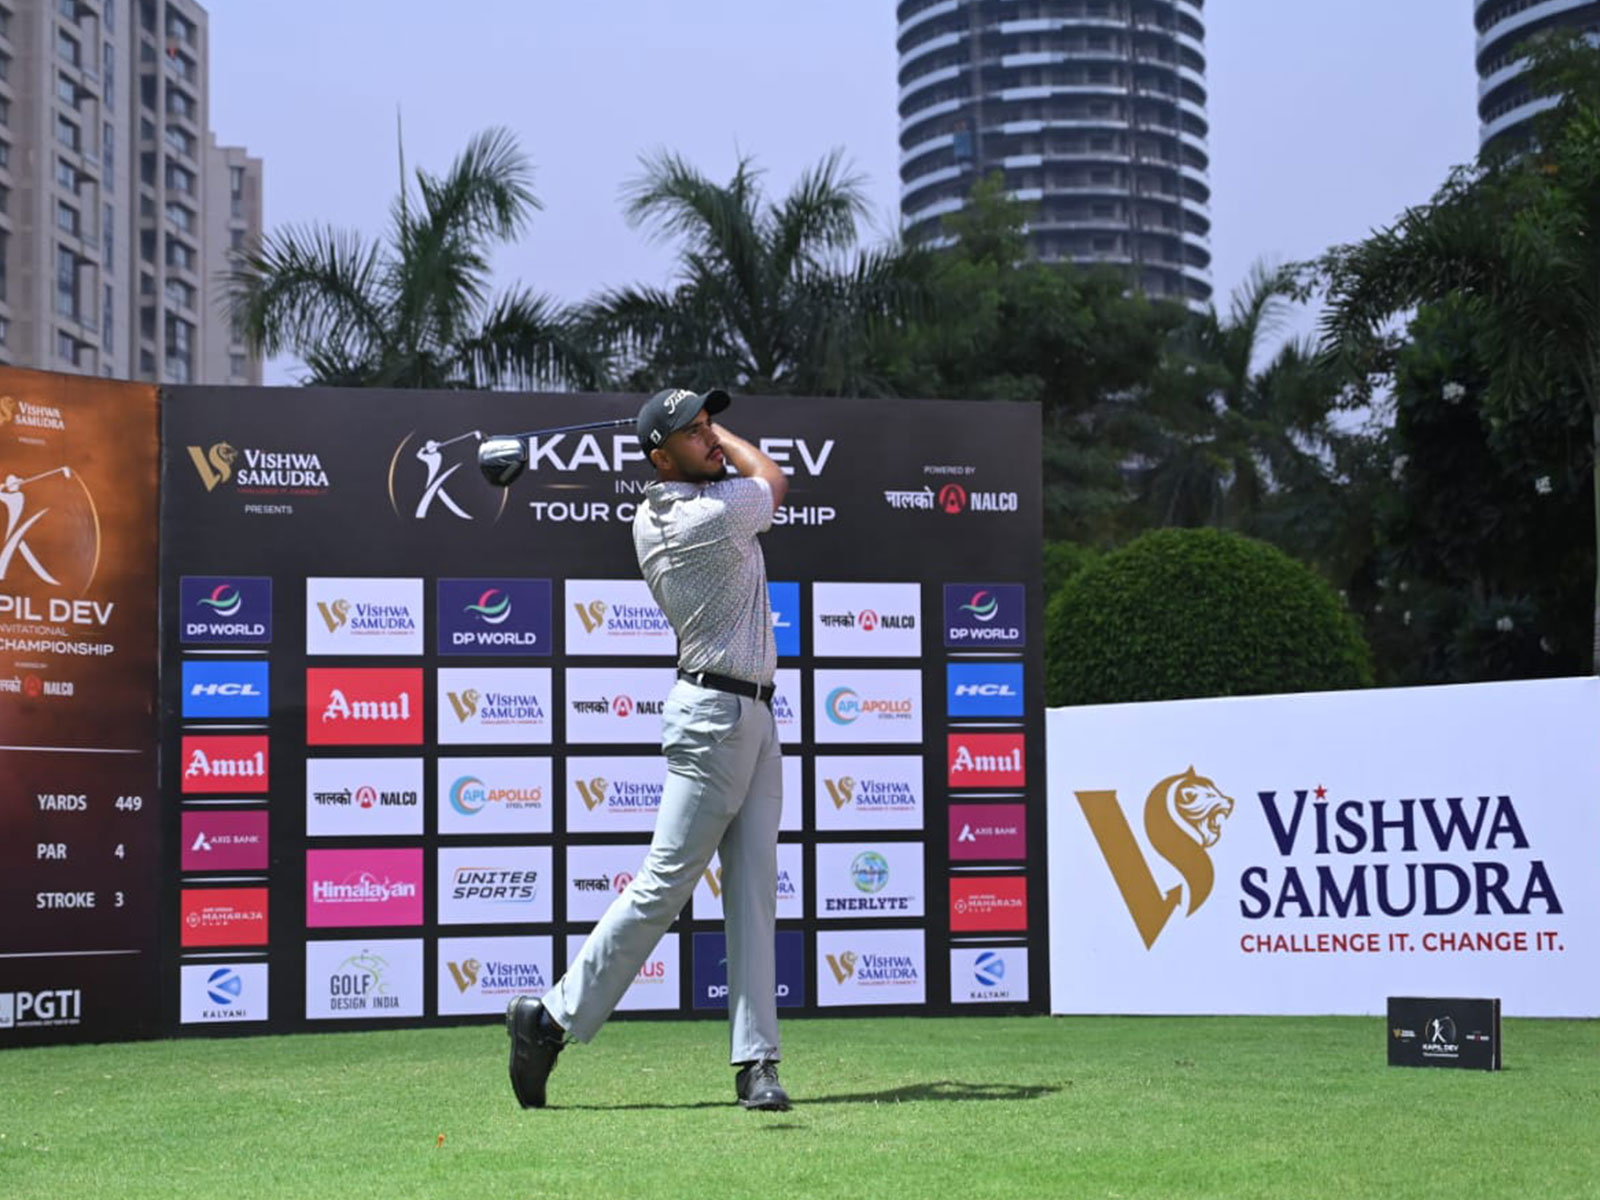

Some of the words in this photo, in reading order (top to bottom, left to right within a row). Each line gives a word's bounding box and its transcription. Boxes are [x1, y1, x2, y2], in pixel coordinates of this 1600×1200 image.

[244, 449, 322, 469] VISHWA
[760, 438, 835, 476] EV
[237, 469, 330, 487] SAMUDRA
[884, 486, 935, 510] नालको
[970, 492, 1018, 511] NALCO
[244, 504, 293, 514] PRESENTS
[529, 502, 610, 522] TOUR
[49, 598, 115, 626] DEV
[356, 603, 410, 617] VISHWA
[351, 617, 416, 630] SAMUDRA
[881, 615, 915, 629] NALCO
[187, 624, 208, 635] DP
[210, 624, 265, 635] WORLD
[950, 628, 969, 639] DP
[970, 628, 1018, 640] WORLD
[453, 633, 475, 645] DP
[477, 633, 536, 645] WORLD
[43, 681, 74, 697] NALCO
[190, 683, 261, 695] HCL
[954, 684, 1016, 696] HCL
[322, 689, 410, 723] Amul
[486, 693, 539, 706] VISHWA
[481, 707, 544, 719] SAMUDRA
[636, 700, 664, 714] NALC
[185, 749, 265, 779] Amul
[951, 745, 1022, 774] Amul
[860, 780, 910, 793] VISHWA
[37, 795, 88, 811] YARDS
[115, 796, 142, 811] 449
[380, 791, 417, 806] NALCO
[856, 794, 916, 805] SAMUDRA
[1257, 788, 1530, 857] VISHWA
[37, 843, 67, 859] PAR
[114, 844, 125, 859] 4
[312, 875, 416, 902] Himalayan
[452, 886, 533, 899] SPORTS
[1239, 860, 1564, 920] SAMUDRA
[36, 892, 96, 908] STROKE
[114, 892, 124, 907] 3
[825, 897, 909, 911] ENERLYTE
[1240, 933, 1380, 953] CHALLENGE
[1388, 933, 1415, 953] IT.
[1422, 932, 1527, 953] CHANGE
[1536, 931, 1564, 952] IT.
[486, 961, 539, 975] VISHWA
[862, 954, 912, 968] VISHWA
[858, 968, 918, 980] SAMUDRA
[331, 974, 370, 995] GOLF
[481, 975, 545, 989] SAMUDRA
[708, 985, 729, 998] DP
[16, 989, 81, 1020] PGTI
[331, 997, 366, 1010] DESIGN
[373, 996, 399, 1009] INDIA
[203, 1010, 246, 1018] KALYANI
